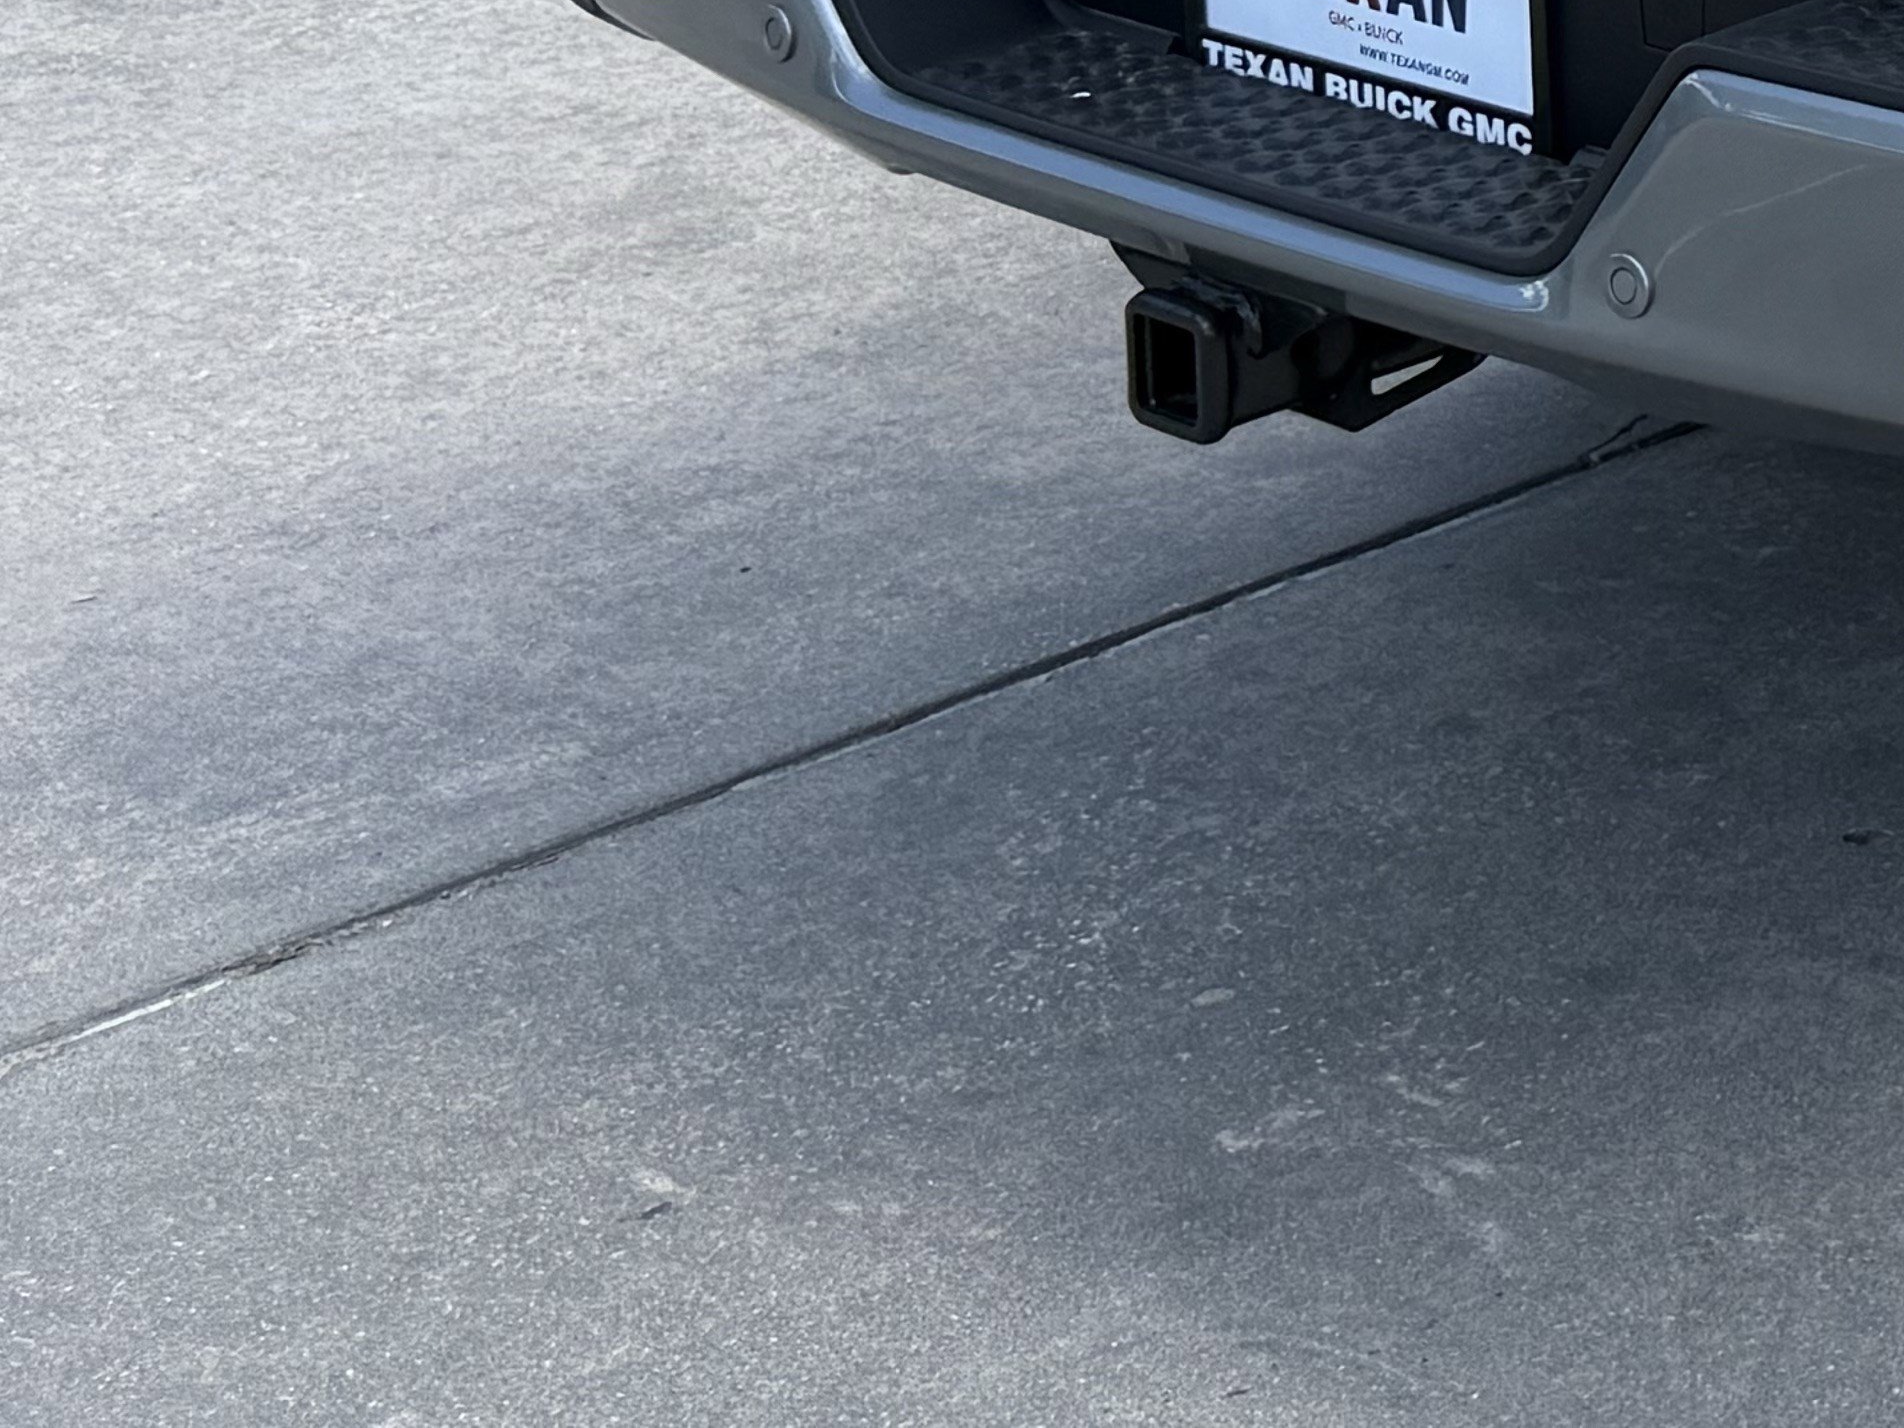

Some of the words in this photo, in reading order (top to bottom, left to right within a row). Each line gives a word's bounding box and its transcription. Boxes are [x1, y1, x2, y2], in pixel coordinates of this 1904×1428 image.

[1364, 21, 1404, 46] BUICK
[1202, 38, 1314, 92] TEXAN
[1325, 72, 1440, 129] BUICK
[1447, 105, 1534, 156] GMC
